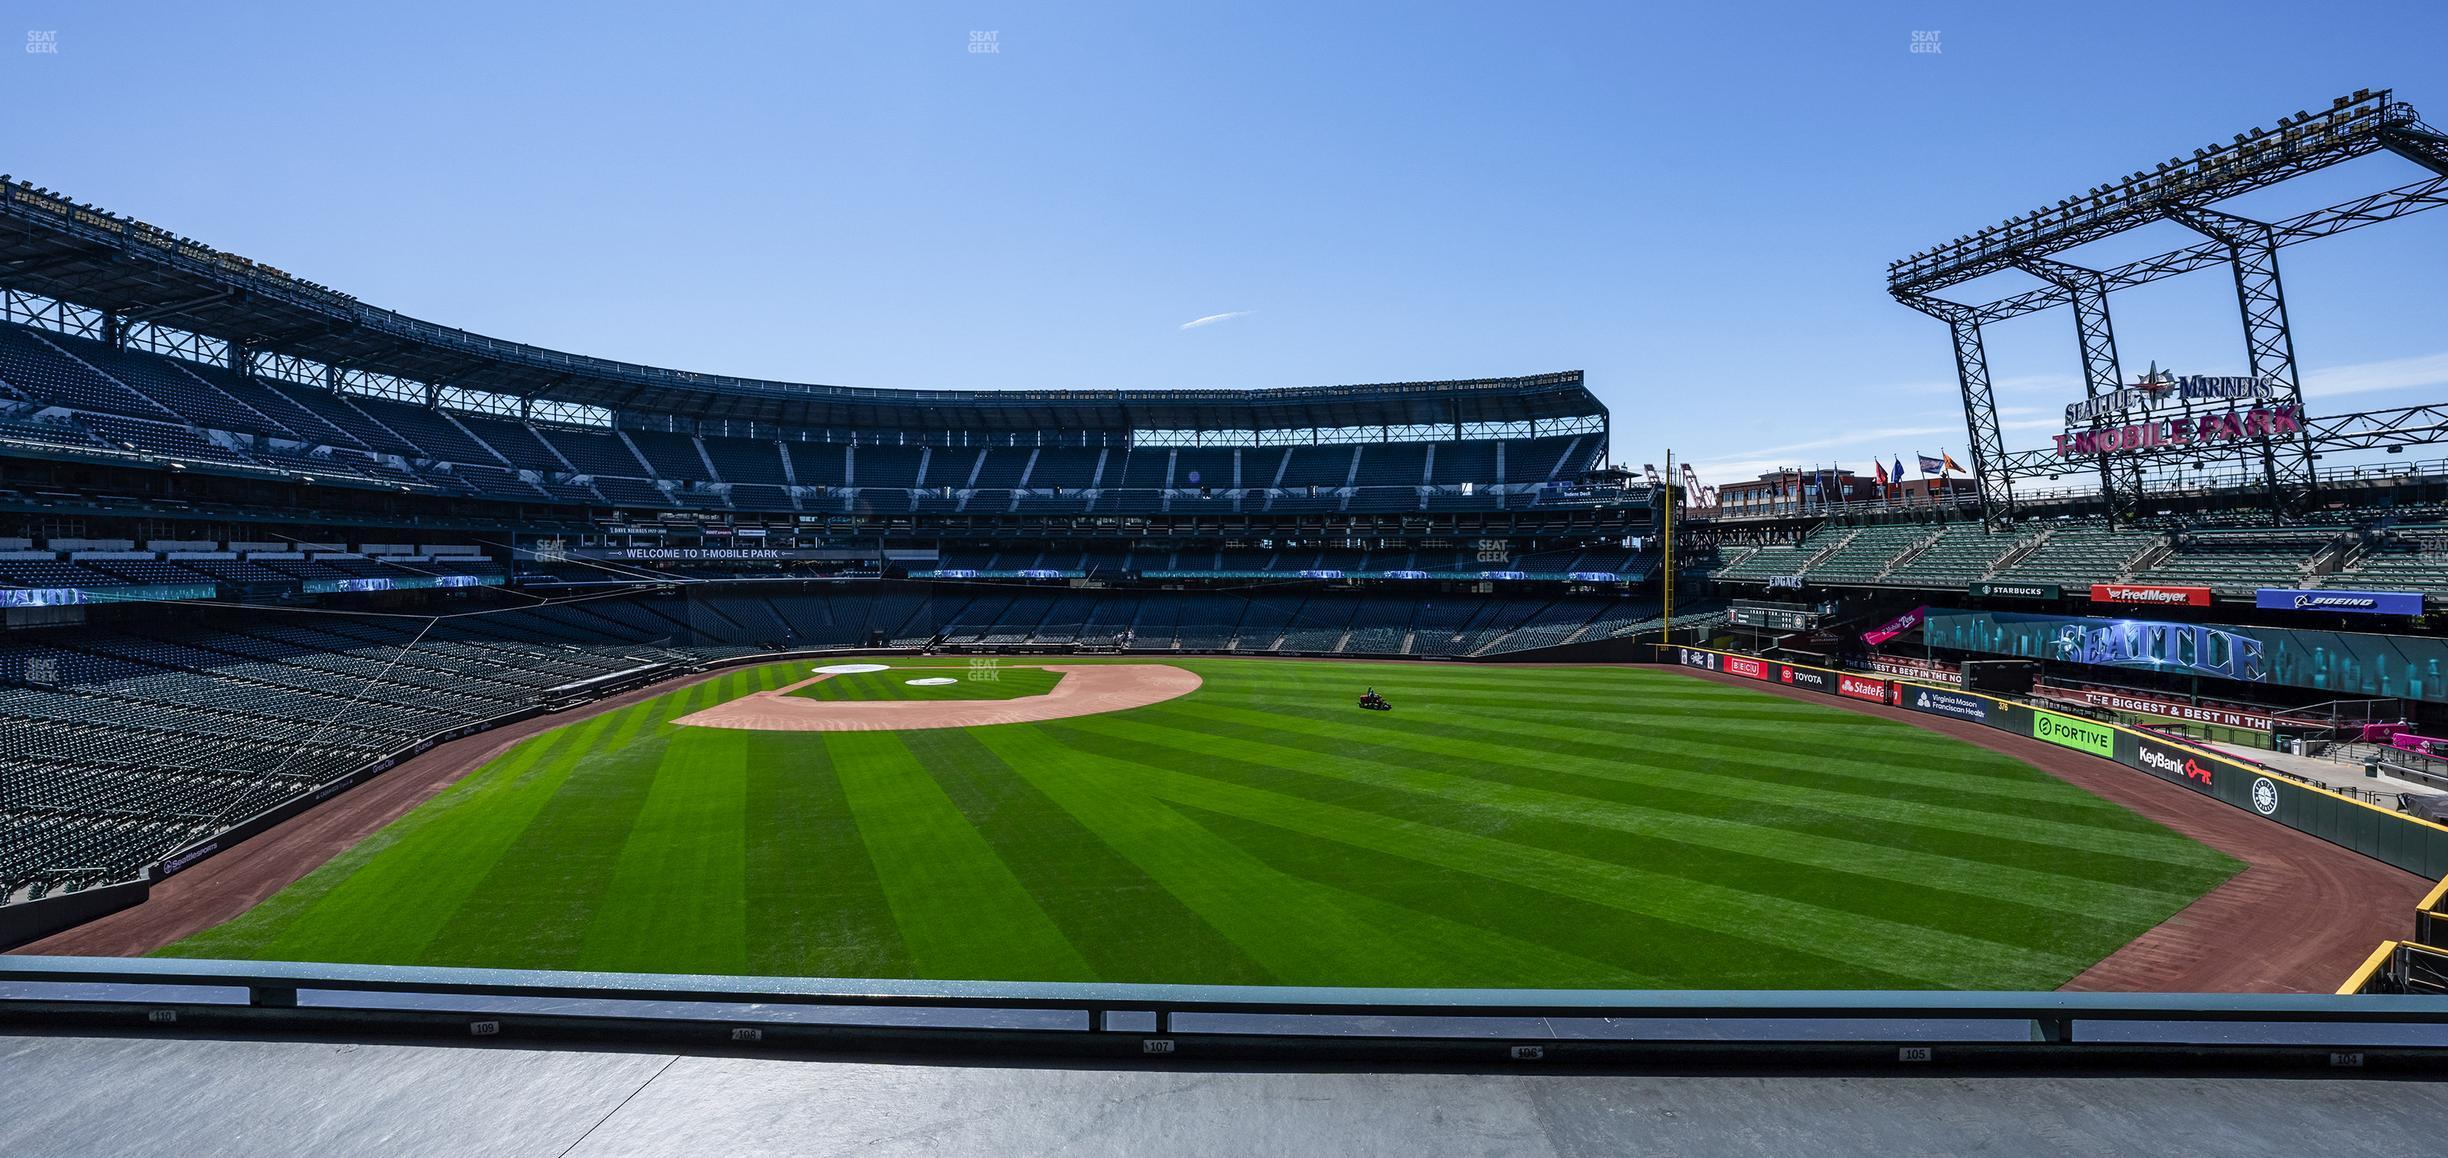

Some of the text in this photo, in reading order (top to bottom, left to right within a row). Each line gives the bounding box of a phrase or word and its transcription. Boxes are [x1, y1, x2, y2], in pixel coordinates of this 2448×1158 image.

[2065, 375, 2274, 426] SEATTLE MARINERS
[2052, 402, 2305, 457] T-MOBILE PARK
[626, 549, 778, 558] WELCOME TO T-MOBILE PARK
[1993, 586, 2042, 595] STARBUCKS
[2312, 597, 2374, 606] BOEING
[1794, 672, 1823, 684] TOYOTA
[1899, 667, 1918, 677] BEST
[1920, 670, 1929, 678] IN
[1930, 671, 1947, 680] THE
[1932, 694, 1977, 708] Virginia Mason
[1932, 702, 1985, 718] Franciscan Health
[2112, 698, 2167, 715] BIGGEST
[2171, 706, 2180, 717] &
[2184, 708, 2220, 722] BEST
[2224, 714, 2240, 725] IN
[2055, 723, 2108, 748] FORTIVE
[2139, 746, 2185, 775] KeyBank
[476, 1023, 494, 1033] 109
[739, 1029, 756, 1039] 108
[1152, 1042, 1168, 1051] 107
[1907, 1049, 1925, 1059] 105
